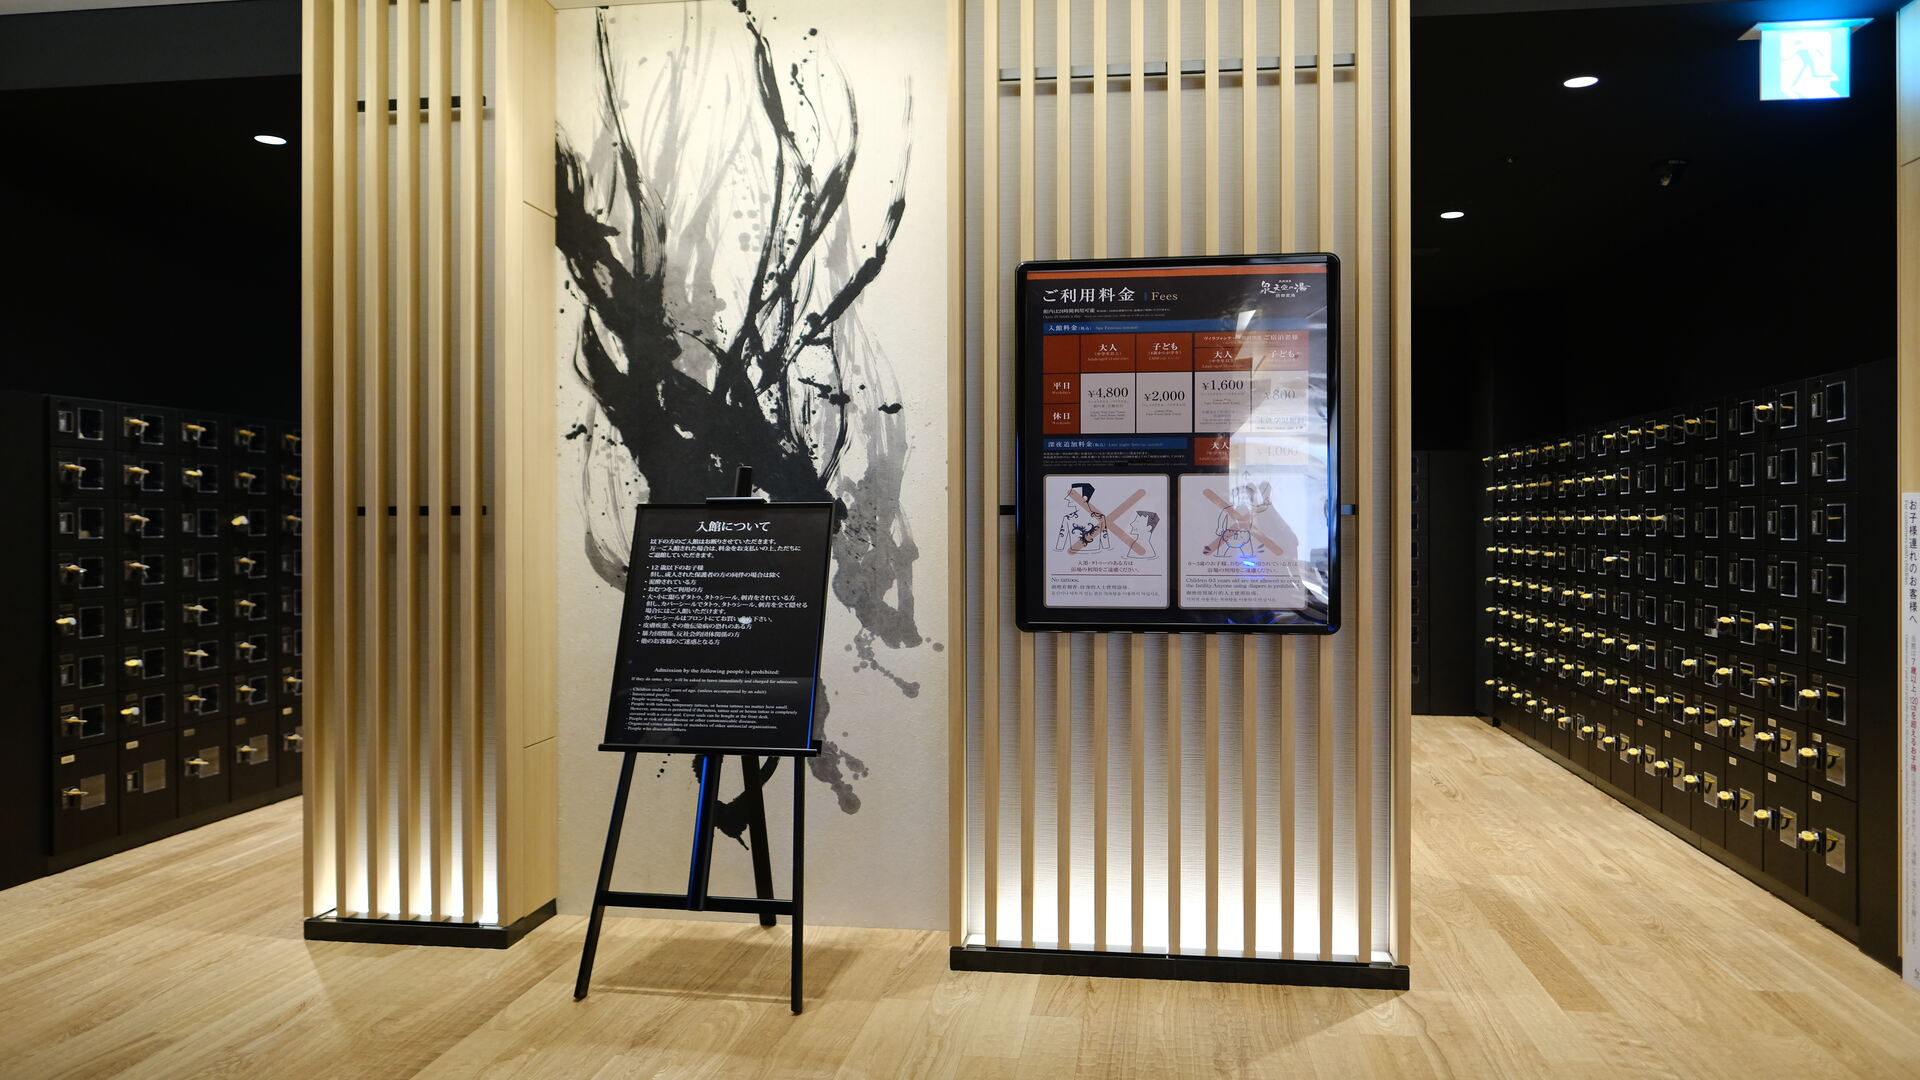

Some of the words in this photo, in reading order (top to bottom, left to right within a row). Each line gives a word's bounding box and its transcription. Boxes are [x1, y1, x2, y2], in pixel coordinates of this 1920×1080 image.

[1043, 286, 1135, 303] ご利用料金
[1151, 291, 1178, 301] Fees
[1100, 344, 1117, 352] 大人
[1153, 342, 1178, 351] 子ども
[1214, 350, 1232, 359] 大人
[1053, 381, 1071, 390] 平日
[1202, 379, 1244, 391] ¥1,600
[1088, 387, 1129, 398] ¥4,800
[1144, 391, 1185, 402] ¥2,000
[1053, 412, 1071, 421] 休日
[1211, 442, 1230, 450] 大人
[695, 520, 771, 533] 入館について
[1909, 500, 1918, 624] お子様連れのお客様へ
